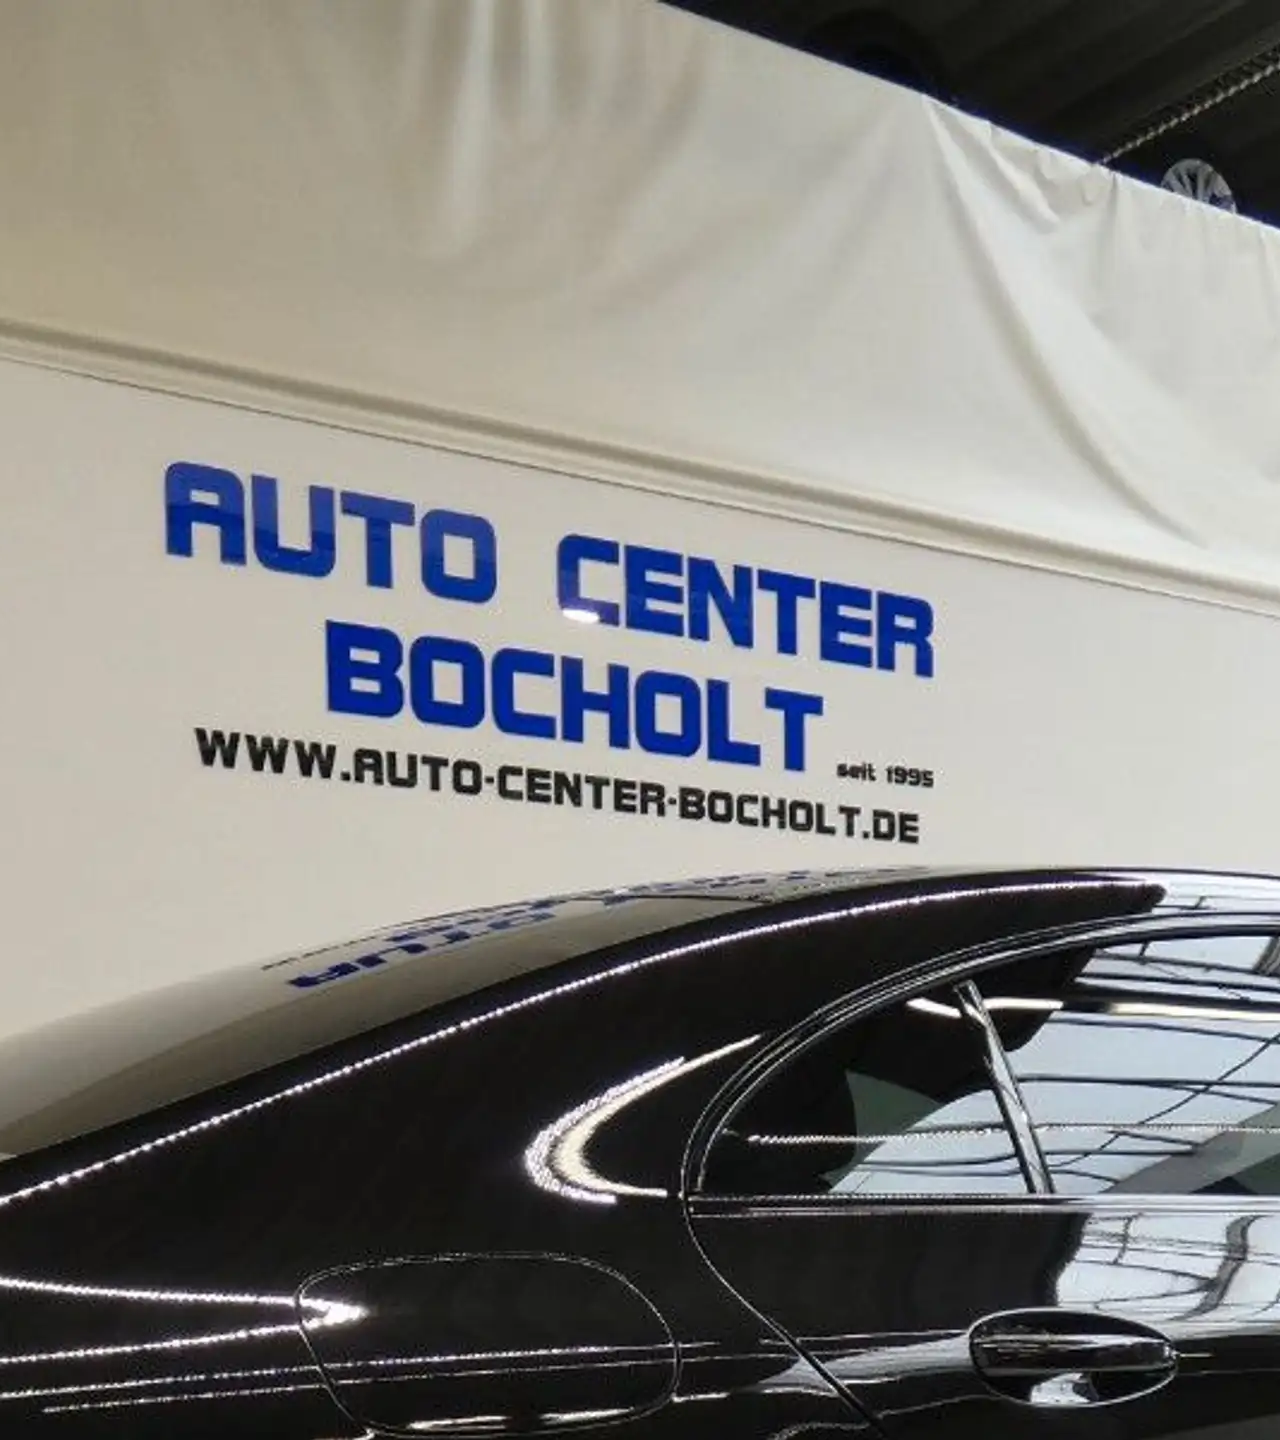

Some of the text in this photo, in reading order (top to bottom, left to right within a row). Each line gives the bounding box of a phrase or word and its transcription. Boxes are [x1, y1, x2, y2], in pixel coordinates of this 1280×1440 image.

[166, 461, 934, 679] AUTO CENTER
[324, 620, 825, 772] BOCHOLT
[194, 727, 921, 844] WWW.AUTO-CENTER-BOCHOLT.DE
[836, 762, 934, 788] seit 1995
